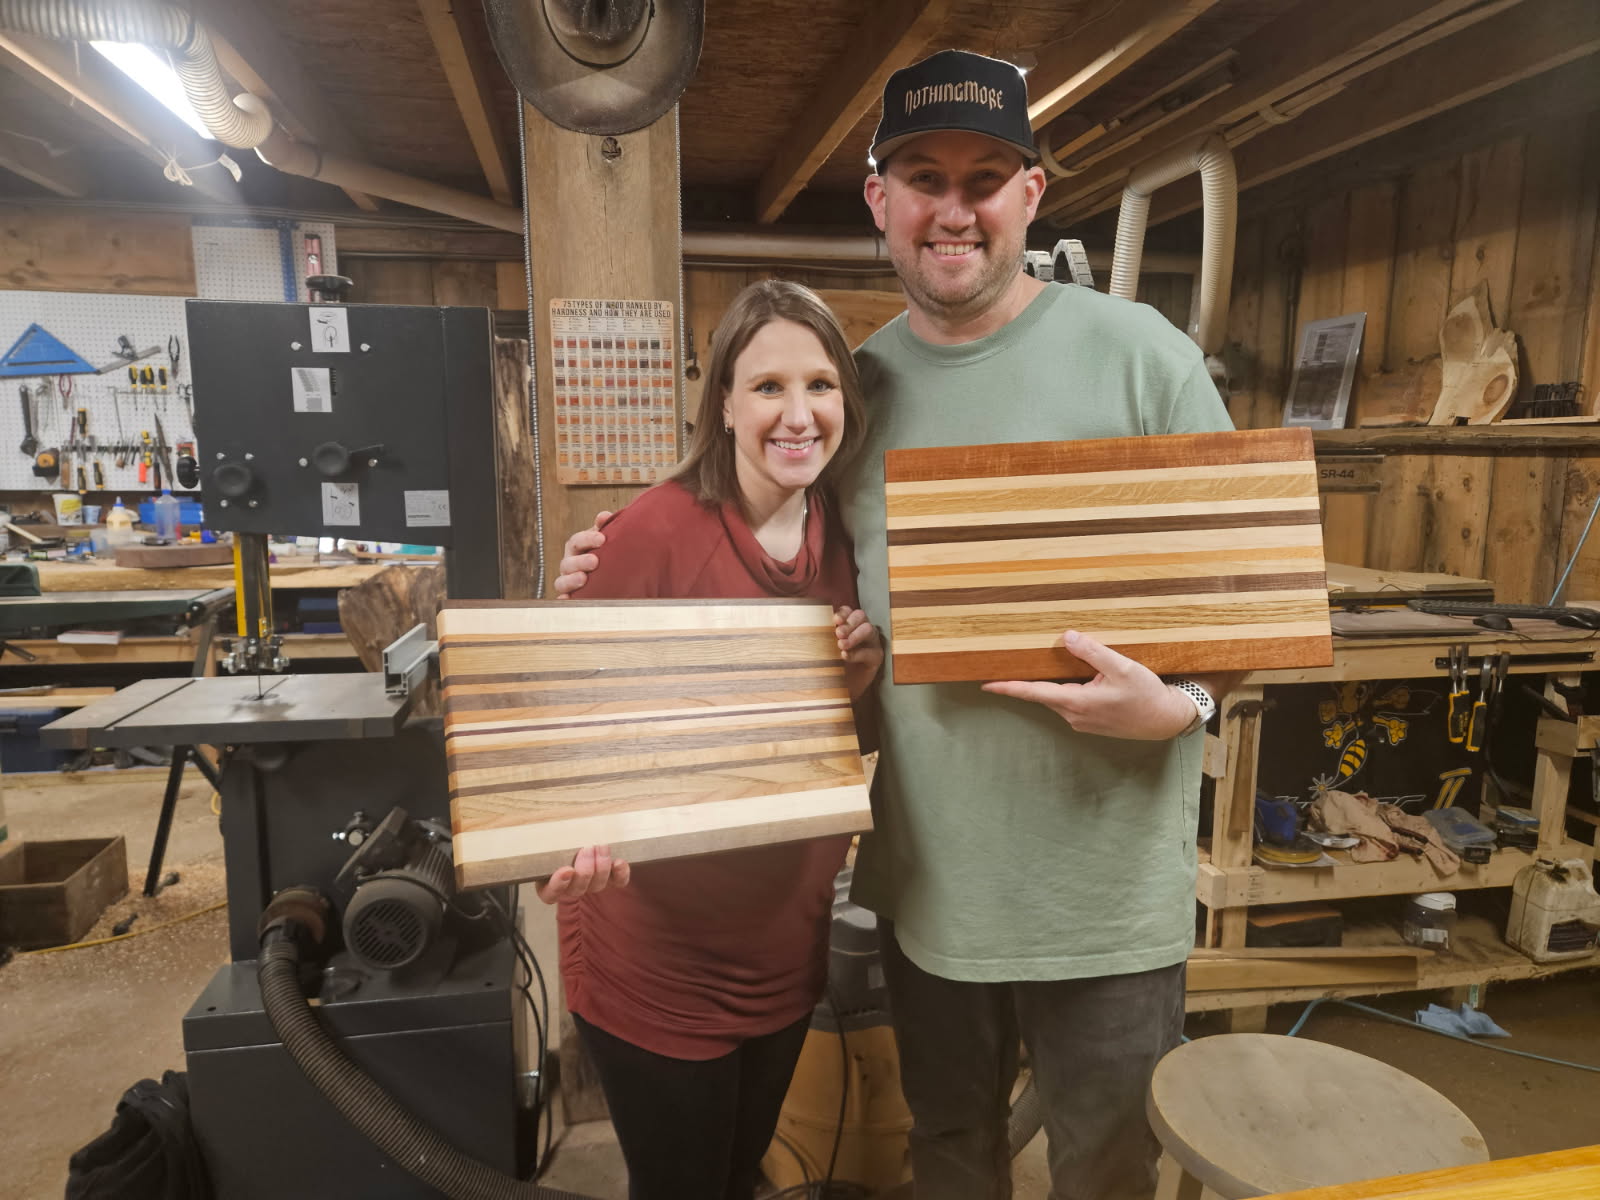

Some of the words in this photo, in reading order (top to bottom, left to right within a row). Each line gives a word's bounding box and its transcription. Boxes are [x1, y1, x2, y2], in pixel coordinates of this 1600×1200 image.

[573, 300, 592, 308] TYPES
[626, 302, 652, 310] RANKED
[552, 308, 587, 316] HARDNESS
[604, 309, 618, 317] HOW
[621, 309, 638, 318] THEY
[1320, 469, 1354, 478] SR-44
